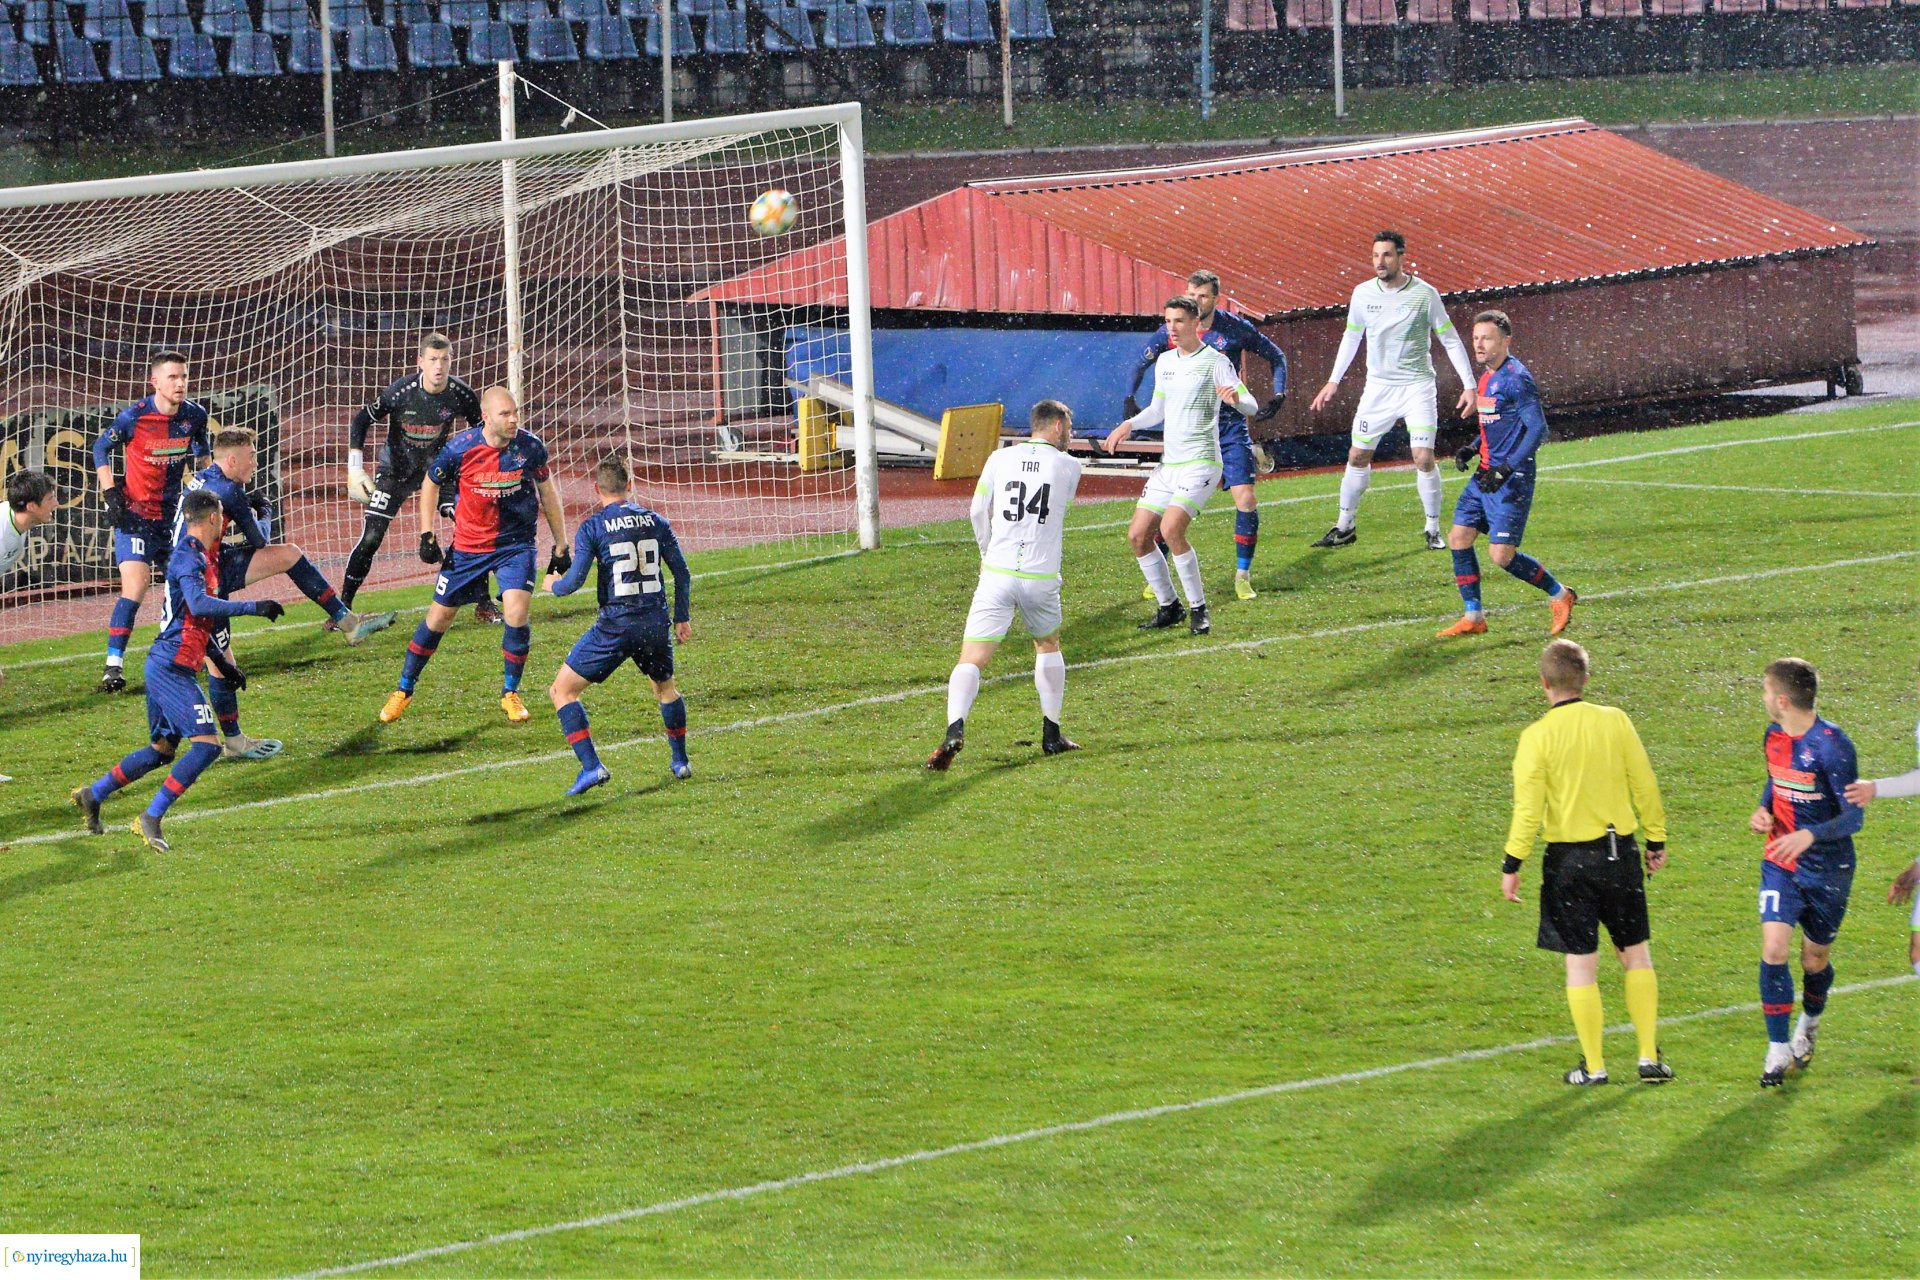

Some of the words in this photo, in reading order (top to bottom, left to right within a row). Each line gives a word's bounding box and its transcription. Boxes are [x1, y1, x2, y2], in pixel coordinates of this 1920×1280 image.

[1359, 420, 1368, 433] 19
[1021, 461, 1040, 473] TAR
[369, 490, 392, 510] 95
[1002, 480, 1050, 525] 34
[604, 515, 655, 533] MAGYAR
[130, 537, 145, 555] 10
[609, 539, 662, 597] 29
[193, 704, 214, 724] 30
